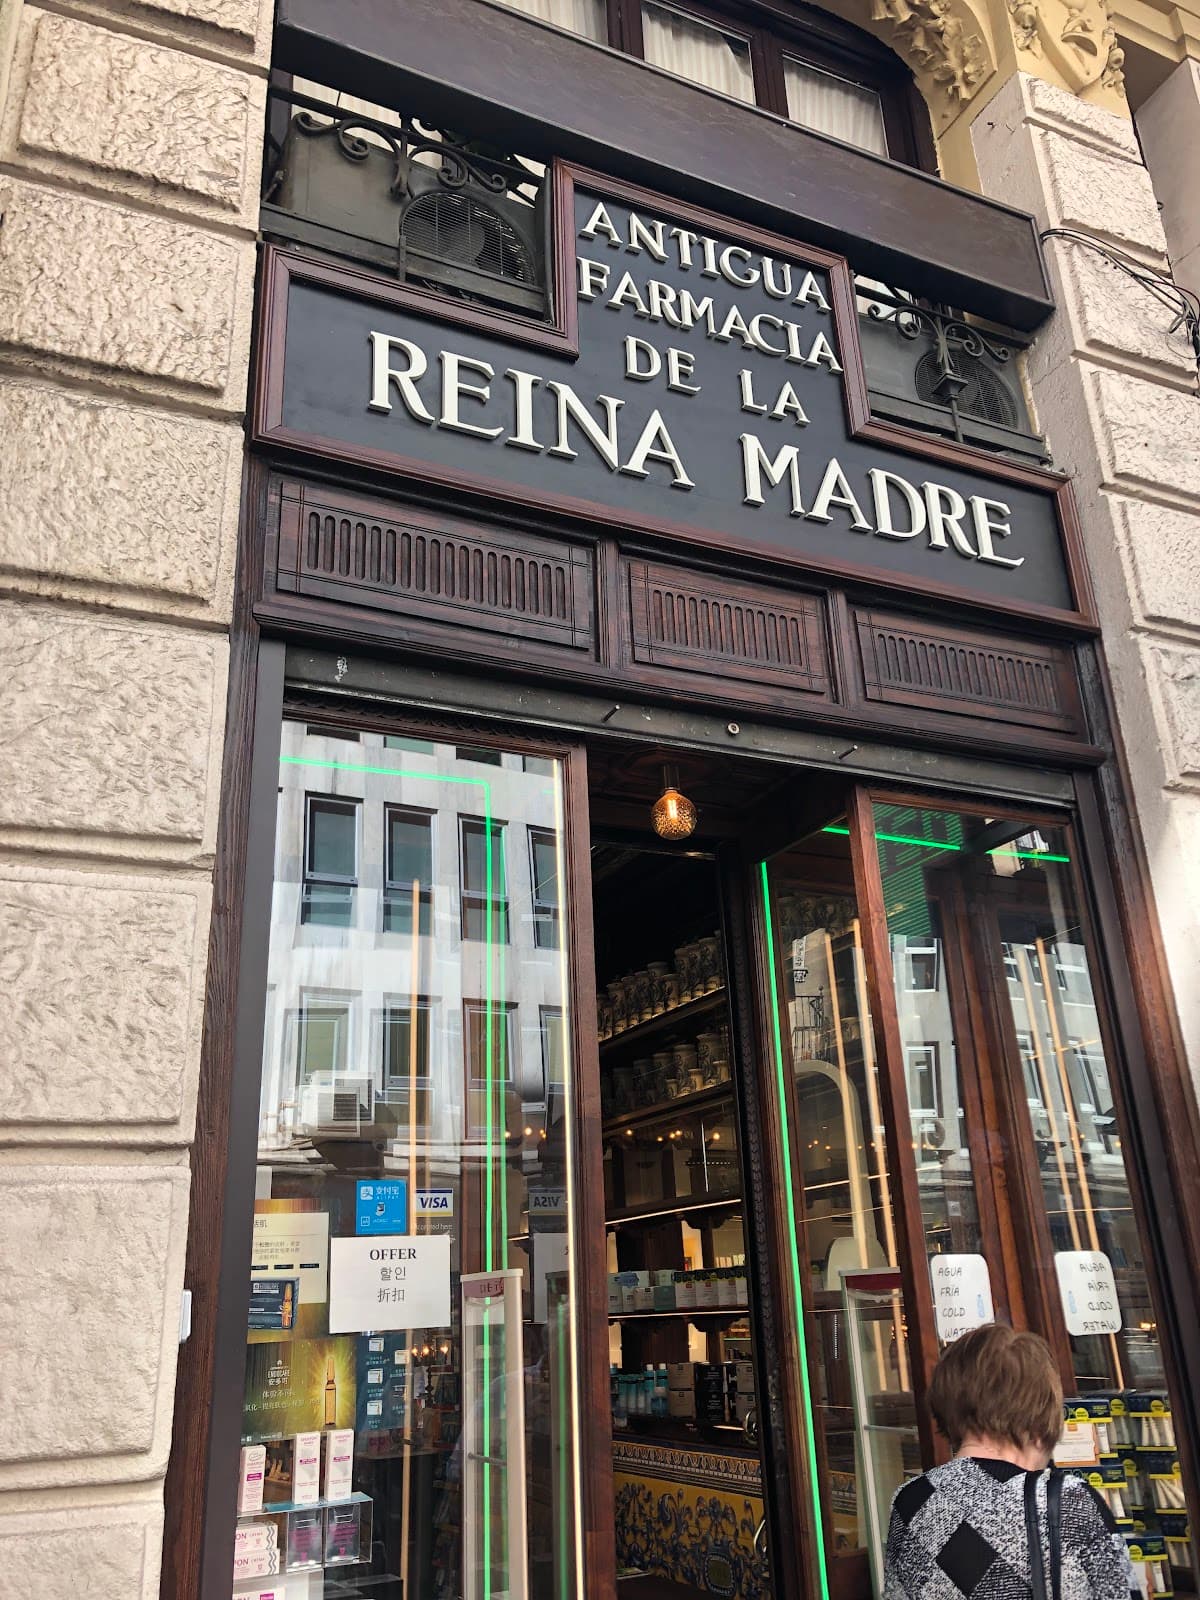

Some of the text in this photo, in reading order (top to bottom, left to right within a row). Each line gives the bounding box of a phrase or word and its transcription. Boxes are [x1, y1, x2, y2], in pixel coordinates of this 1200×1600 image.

[579, 201, 832, 311] ANTIGUA
[577, 256, 844, 374] FARMACIA
[624, 334, 810, 427] DE LA
[368, 329, 1026, 569] REINA MADRE
[420, 1196, 448, 1209] VISA
[369, 1248, 417, 1261] OFFER
[380, 1266, 406, 1281] 할인
[937, 1266, 963, 1277] AGUA
[377, 1287, 405, 1303] 折扣
[942, 1307, 966, 1318] COLD
[944, 1327, 977, 1339] WAT
